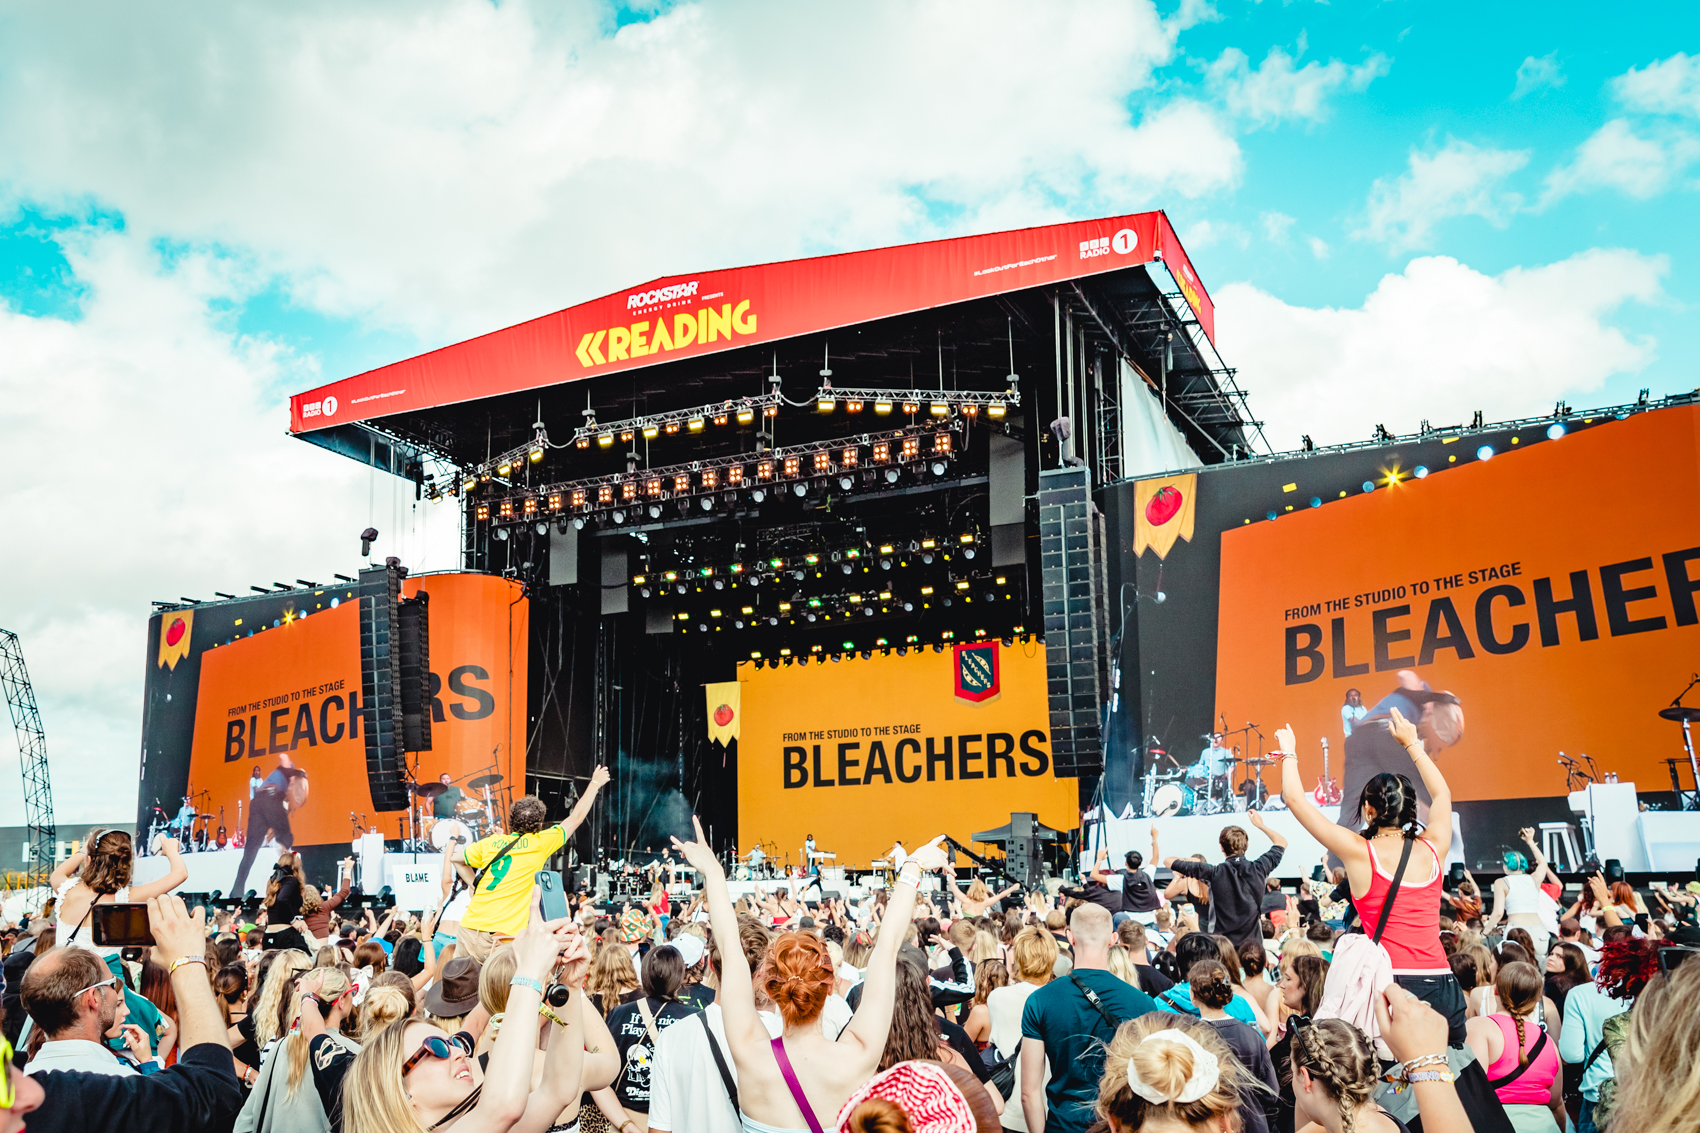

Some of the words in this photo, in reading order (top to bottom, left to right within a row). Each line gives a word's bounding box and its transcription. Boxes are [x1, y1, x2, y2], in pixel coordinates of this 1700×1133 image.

[1079, 247, 1110, 260] RADIO
[627, 281, 699, 310] ROCKSTAR
[701, 292, 724, 301] PRESENTS
[632, 305, 663, 316] ENERGY
[666, 299, 692, 309] DRINK
[608, 299, 757, 363] READING
[302, 409, 322, 419] RADIO
[1284, 603, 1322, 622] FROM
[1324, 597, 1351, 614] THE
[1354, 585, 1406, 608] STUDIO
[1410, 581, 1430, 596] TO
[1433, 573, 1464, 592] THE
[1468, 561, 1522, 585] STAGE
[961, 650, 991, 689] BLEACHERS
[227, 704, 247, 718] FROM
[248, 701, 261, 713] THE
[262, 694, 289, 709] STUDIO
[290, 691, 301, 702] TO
[302, 686, 317, 699] THE
[318, 679, 345, 695] STAGE
[782, 732, 807, 743] FROM
[808, 730, 825, 741] THE
[826, 728, 859, 740] STUDIO
[860, 727, 872, 737] TO
[873, 726, 891, 736] THE
[892, 723, 922, 735] STAGE
[783, 729, 1050, 790] BLEACHERS
[405, 872, 430, 883] BLAME
[486, 854, 513, 891] 9
[630, 1012, 642, 1025] If
[621, 1023, 646, 1037] Play
